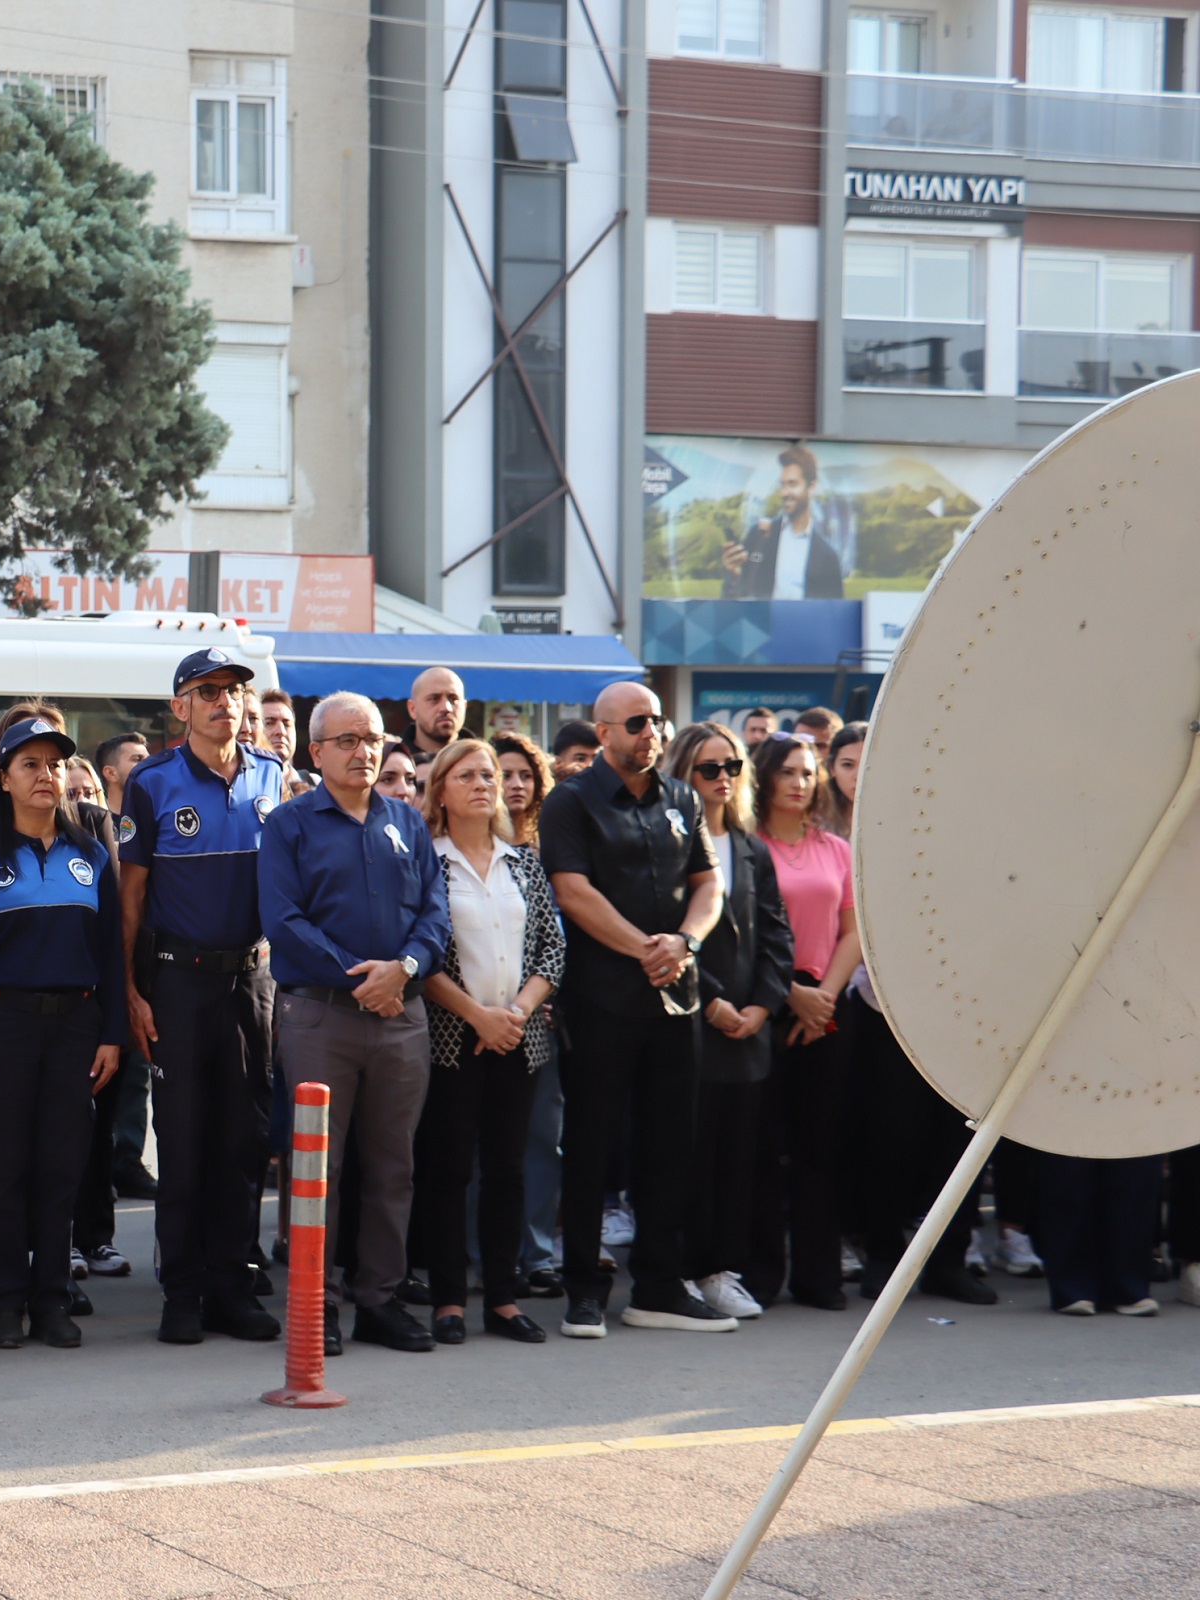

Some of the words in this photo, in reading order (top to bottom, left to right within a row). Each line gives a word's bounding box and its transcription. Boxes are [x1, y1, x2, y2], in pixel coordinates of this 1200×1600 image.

[843, 171, 963, 202] TUNAHAN
[967, 177, 1025, 205] YAPI
[135, 576, 284, 613] MAKET
